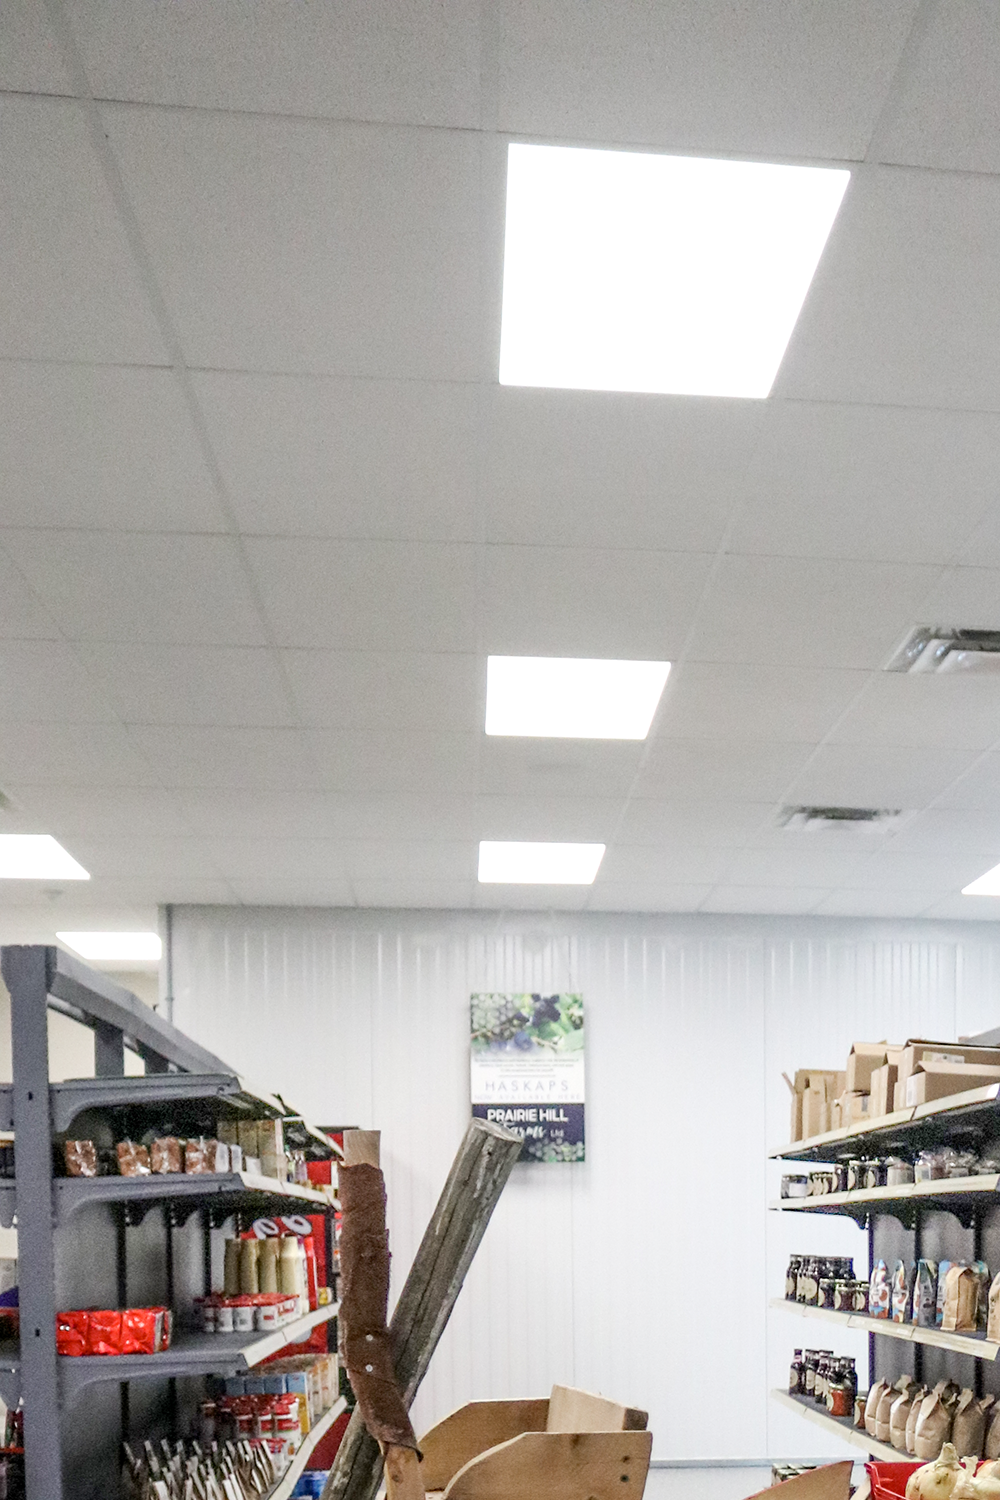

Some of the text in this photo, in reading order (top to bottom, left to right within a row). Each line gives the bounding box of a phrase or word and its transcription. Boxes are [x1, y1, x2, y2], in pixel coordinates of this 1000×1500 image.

[485, 1080, 569, 1092] HASKAPS
[487, 1108, 569, 1121] PRAIRIE HILL
